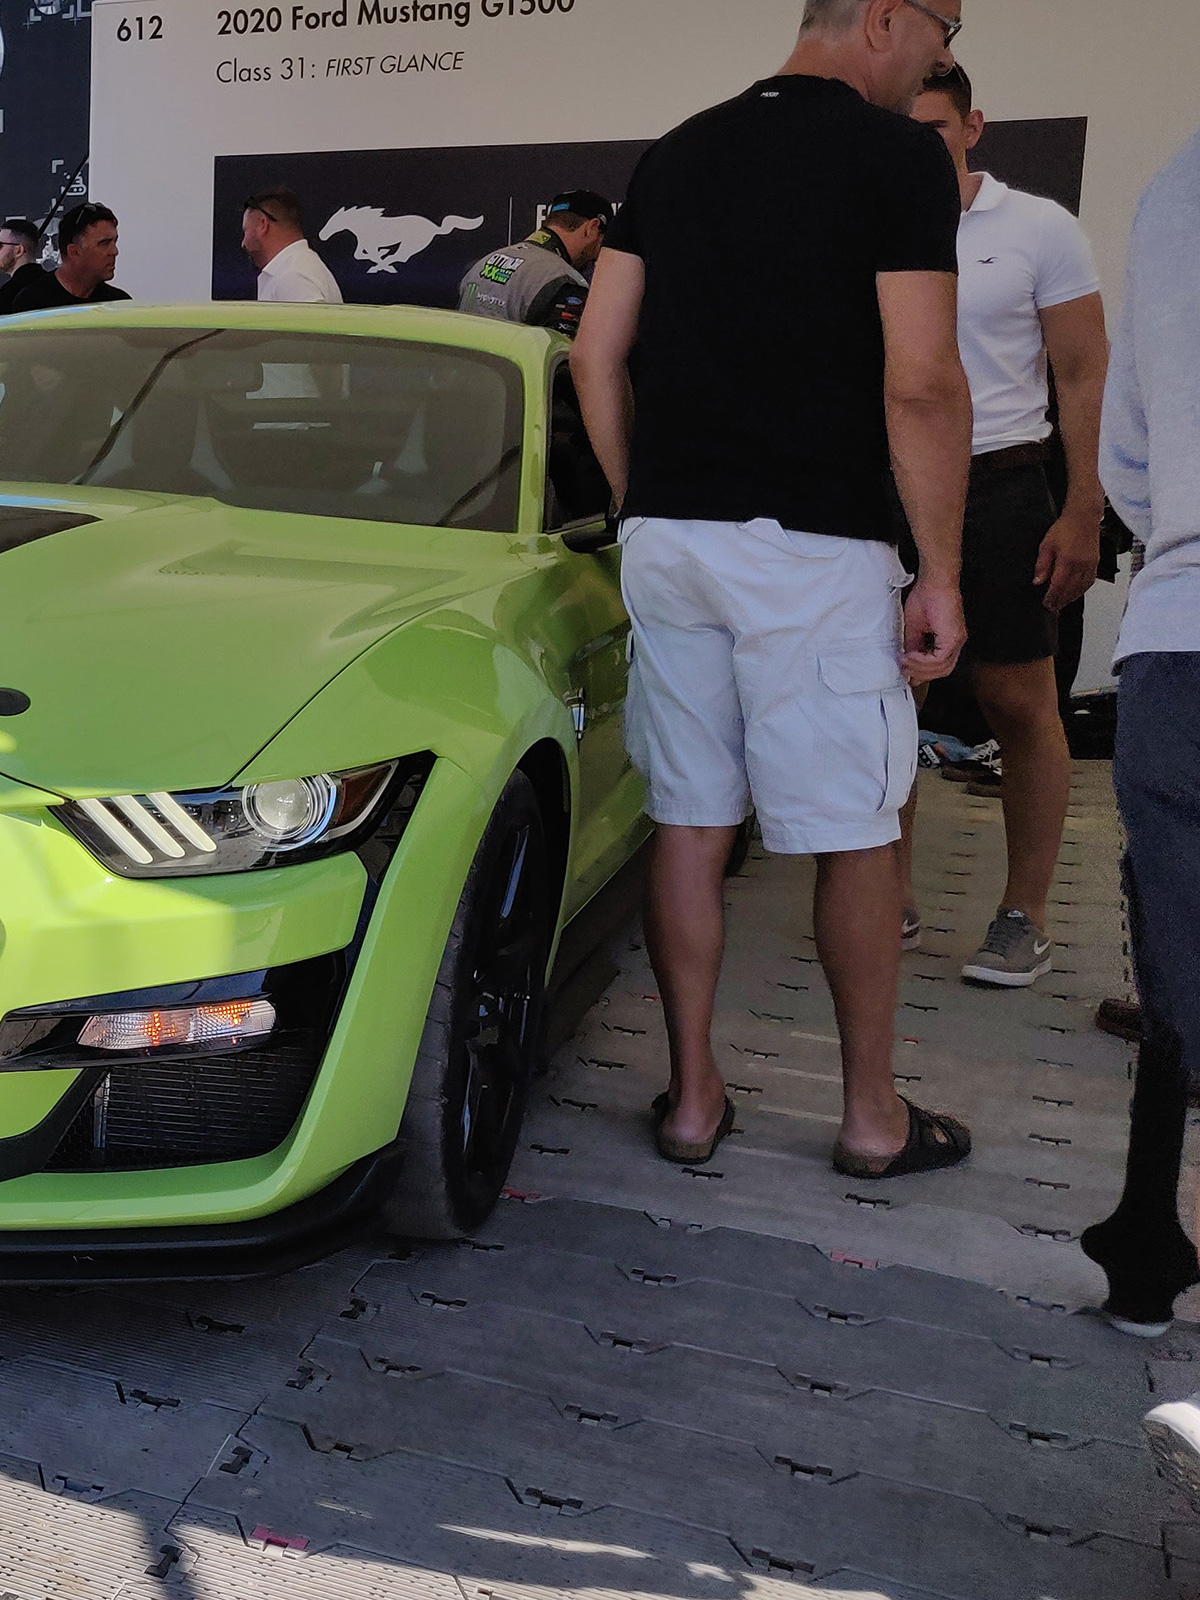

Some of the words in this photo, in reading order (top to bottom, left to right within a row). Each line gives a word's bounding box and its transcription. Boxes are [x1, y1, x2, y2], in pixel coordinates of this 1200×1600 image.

[116, 14, 163, 42] 612
[216, 6, 282, 36] 2020
[292, 0, 347, 31] Ford
[357, 0, 471, 28] Mustang
[216, 58, 272, 83] Class
[280, 57, 316, 80] 31:
[325, 56, 375, 78] FIRST
[379, 51, 465, 74] GLANCE
